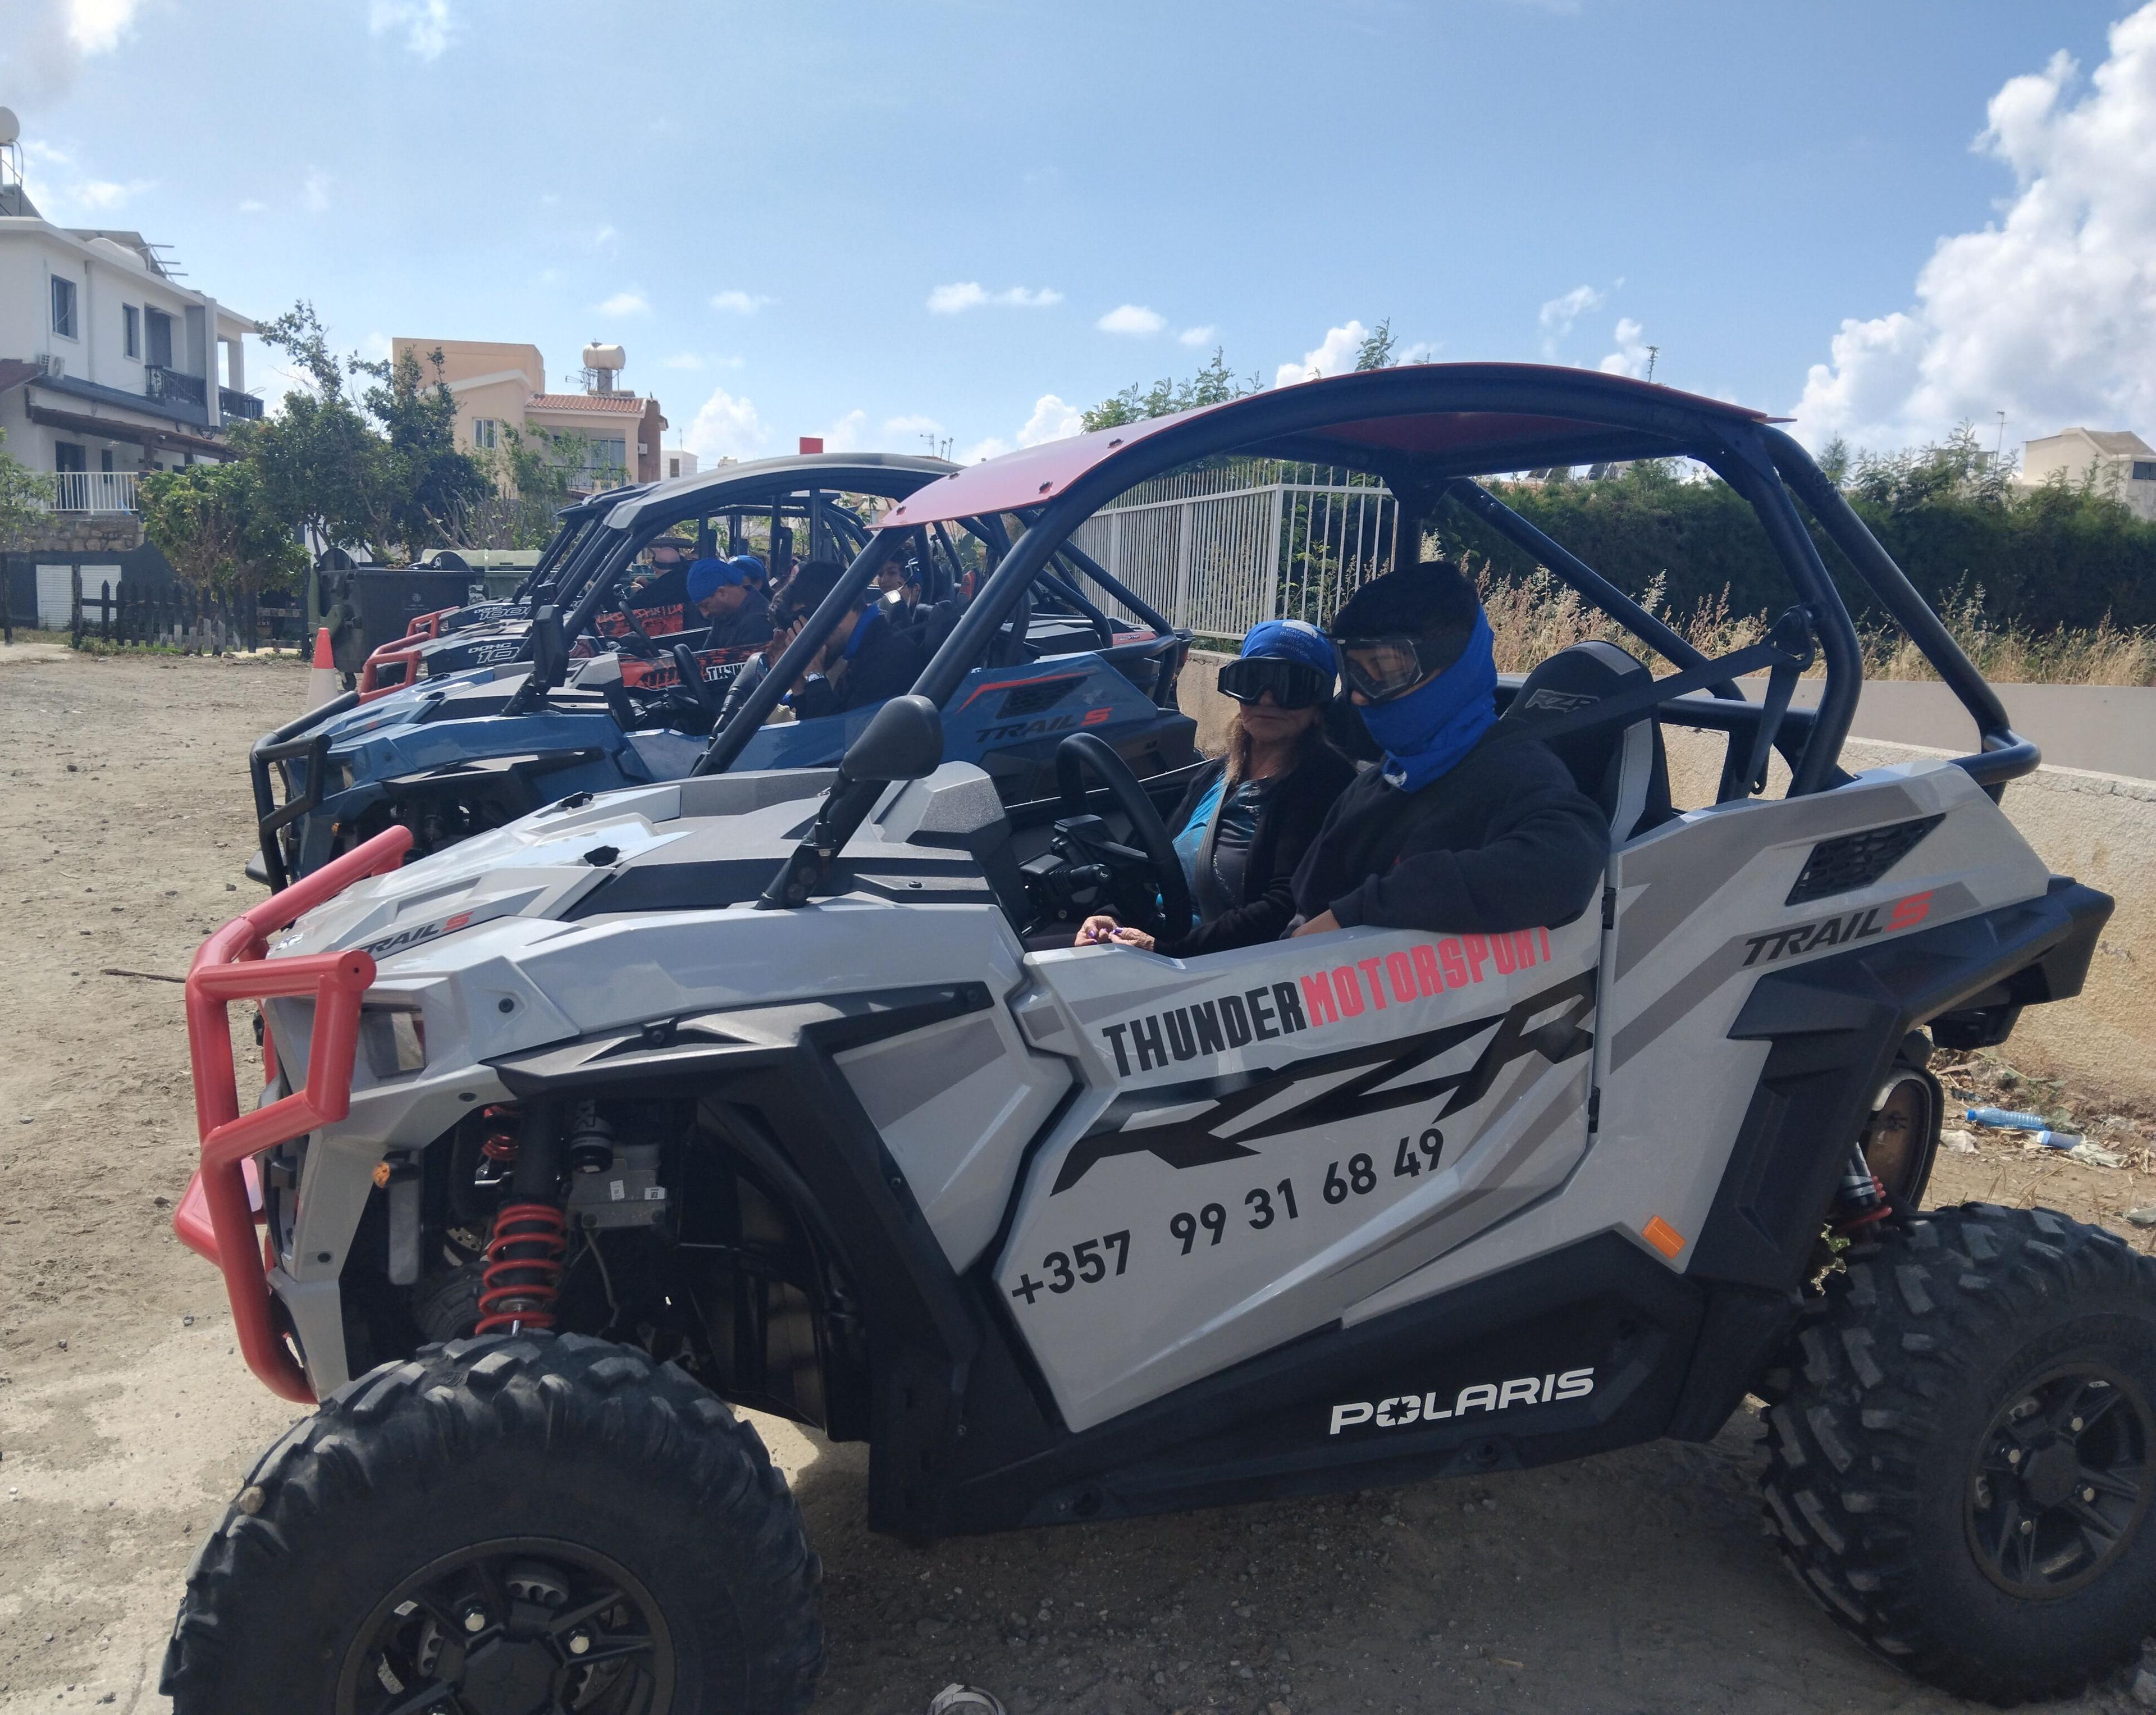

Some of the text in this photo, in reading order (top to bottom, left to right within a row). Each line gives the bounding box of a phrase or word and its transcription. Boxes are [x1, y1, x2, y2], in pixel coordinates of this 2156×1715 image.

[468, 642, 511, 654] DOHC
[976, 706, 1114, 743] TRAIL S
[442, 910, 474, 932] S
[1742, 890, 1934, 967] TRAIL S
[1011, 1128, 1444, 1305] +357 99 31 68 49
[1329, 1367, 1595, 1435] POLARIS
